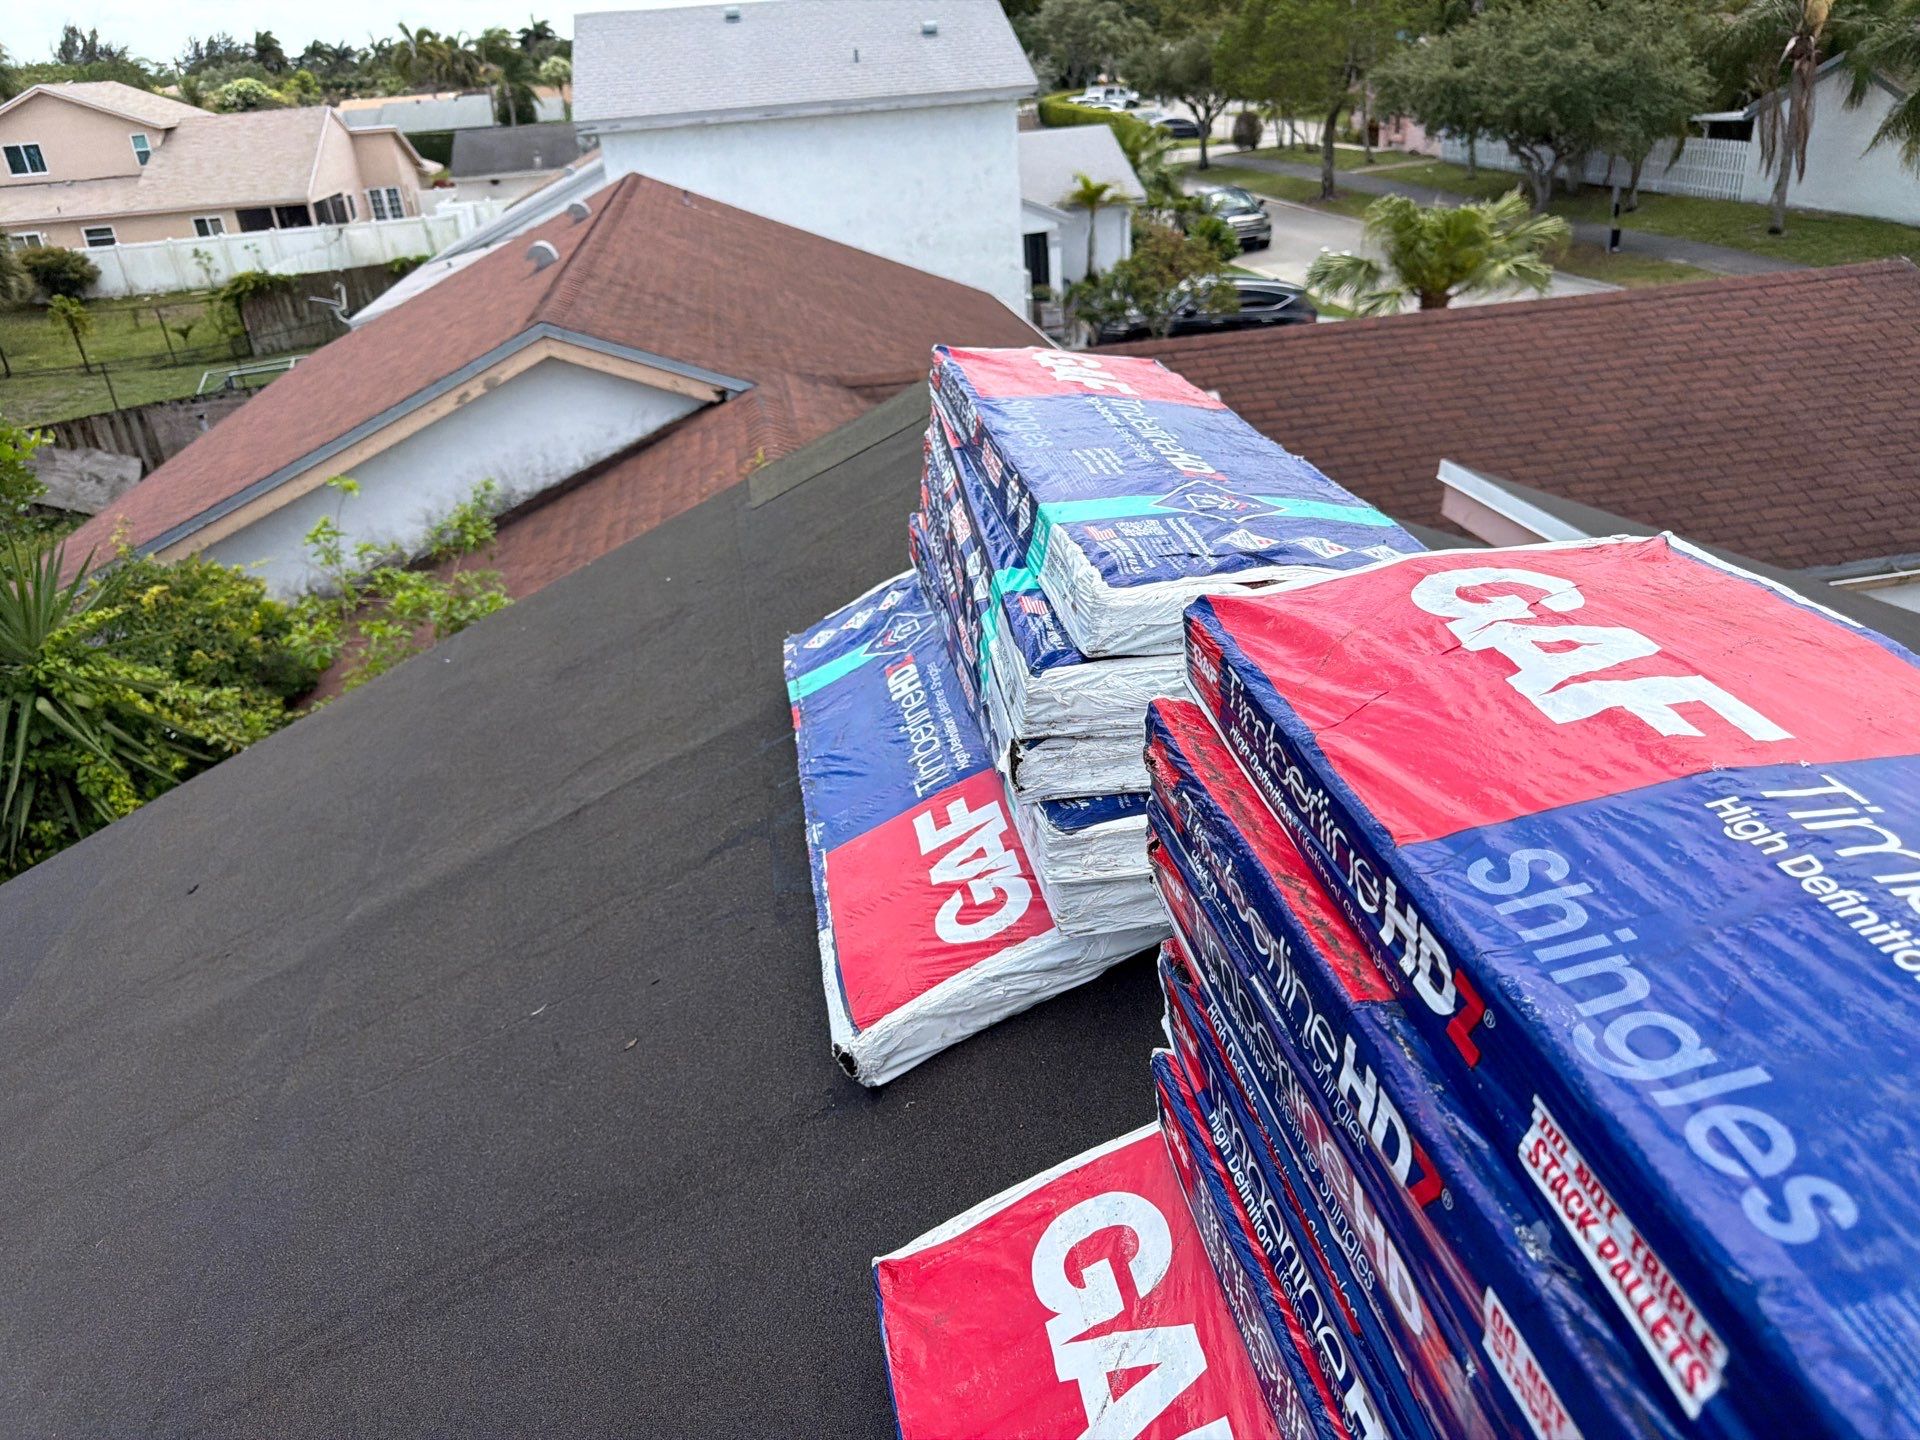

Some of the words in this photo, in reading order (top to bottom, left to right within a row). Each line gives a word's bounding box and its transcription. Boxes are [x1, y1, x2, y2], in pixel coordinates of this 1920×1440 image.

[1411, 567, 1795, 742] GAF
[953, 749, 972, 772] High
[1229, 720, 1250, 758] High
[914, 796, 1034, 944] GAF
[1704, 795, 1789, 855] High
[1776, 853, 1920, 984] Definitio
[1206, 1002, 1227, 1047] High
[1467, 849, 1861, 1245] Shingles
[1209, 1110, 1229, 1154] High
[1319, 1181, 1376, 1291] Shingles
[1526, 1137, 1599, 1243] STACK
[1597, 1235, 1708, 1397] PALLETS
